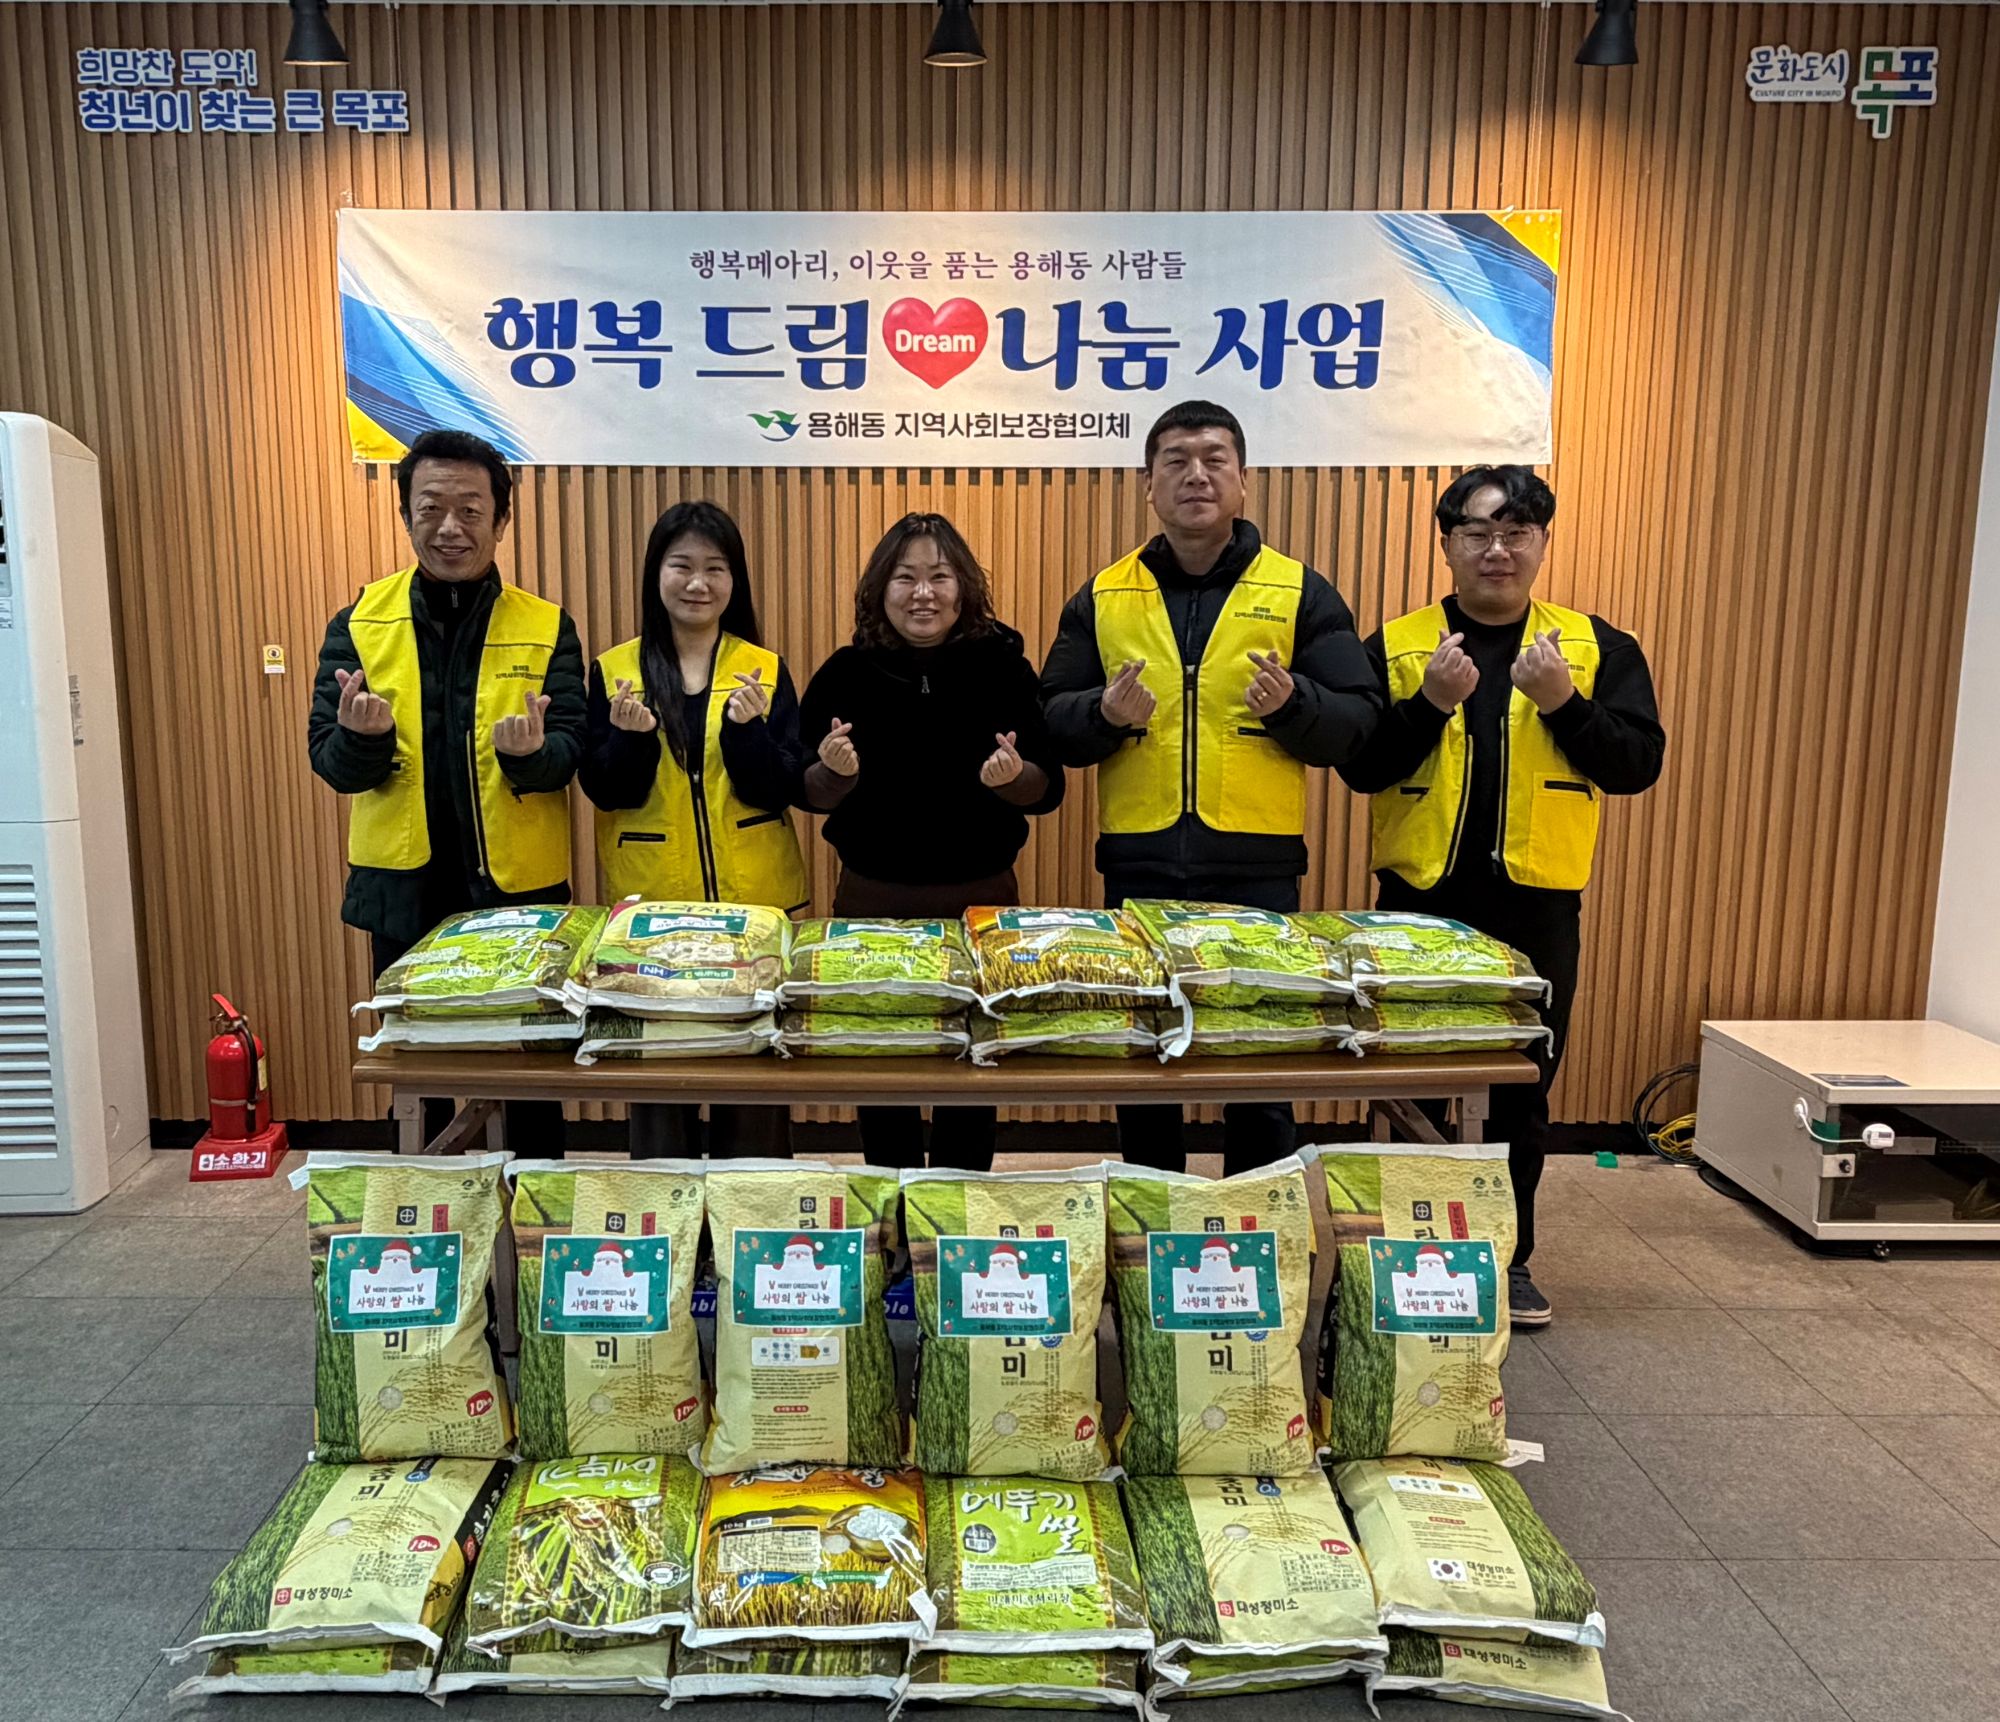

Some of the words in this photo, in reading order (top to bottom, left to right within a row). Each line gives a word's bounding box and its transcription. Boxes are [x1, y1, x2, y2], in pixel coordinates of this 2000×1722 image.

[78, 49, 173, 85] 희망찬
[181, 49, 256, 84] 도약!
[1750, 50, 1846, 84] 문화도시
[81, 91, 191, 130] 청년이
[200, 91, 275, 130] 찾는
[285, 91, 323, 130] 큰
[334, 91, 408, 131] 목포
[690, 249, 840, 282] 행복메아리,
[849, 250, 932, 281] 이웃을
[941, 251, 999, 281] 품는
[1007, 250, 1092, 281] 용해동
[1101, 249, 1187, 281] 사람들
[484, 297, 673, 390] 행복
[696, 299, 869, 391] 드림
[894, 328, 976, 353] Dream
[995, 299, 1180, 391] 나눔
[1195, 299, 1385, 390] 사업
[807, 411, 885, 438] 용해동
[894, 411, 1131, 439] 지역사회보장협의체
[1013, 954, 1034, 962] NH
[643, 966, 665, 977] NH
[214, 1152, 267, 1166] 소화기
[357, 1297, 386, 1308] 사랑의
[571, 1299, 598, 1311] 사랑의
[763, 1292, 791, 1304] 사랑의
[1181, 1296, 1210, 1308] 사랑의
[1402, 1299, 1430, 1312] 사랑의
[971, 1302, 998, 1313] 사랑의
[595, 1337, 618, 1363] 미
[1208, 1345, 1233, 1371] 미
[1001, 1352, 1026, 1378] 미
[961, 1489, 1077, 1523] 메뚜기
[742, 1572, 765, 1586] NH
[293, 1587, 354, 1602] 대성정미소
[1236, 1599, 1300, 1616] 대성정미소
[1464, 1648, 1527, 1670] 대성정미소
